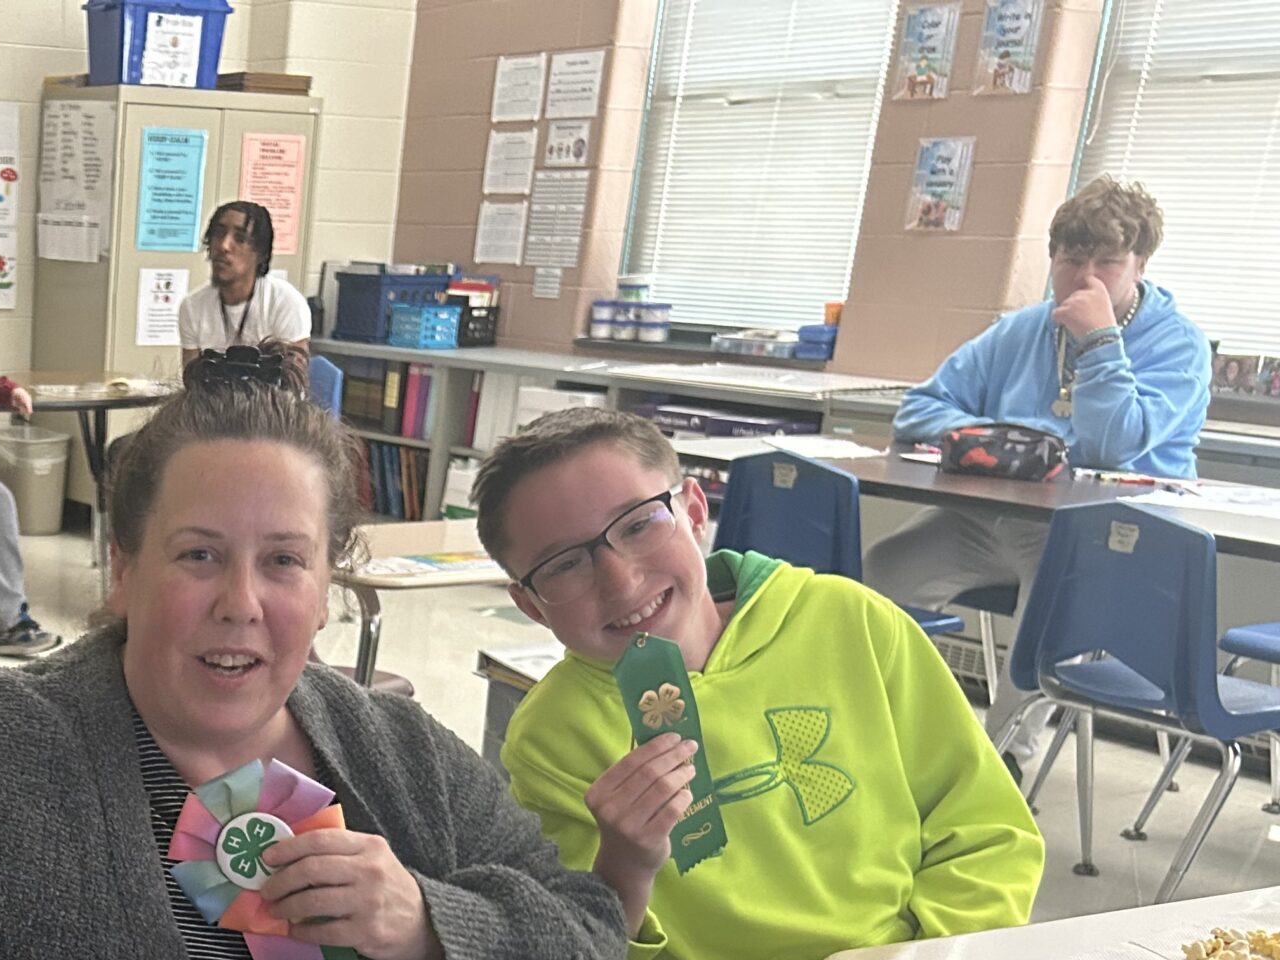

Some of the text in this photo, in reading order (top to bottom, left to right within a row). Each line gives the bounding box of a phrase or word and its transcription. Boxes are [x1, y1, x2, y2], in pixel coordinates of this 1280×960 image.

[997, 12, 1020, 21] Write
[253, 823, 267, 838] H
[227, 835, 242, 849] H
[238, 858, 251, 873] H
